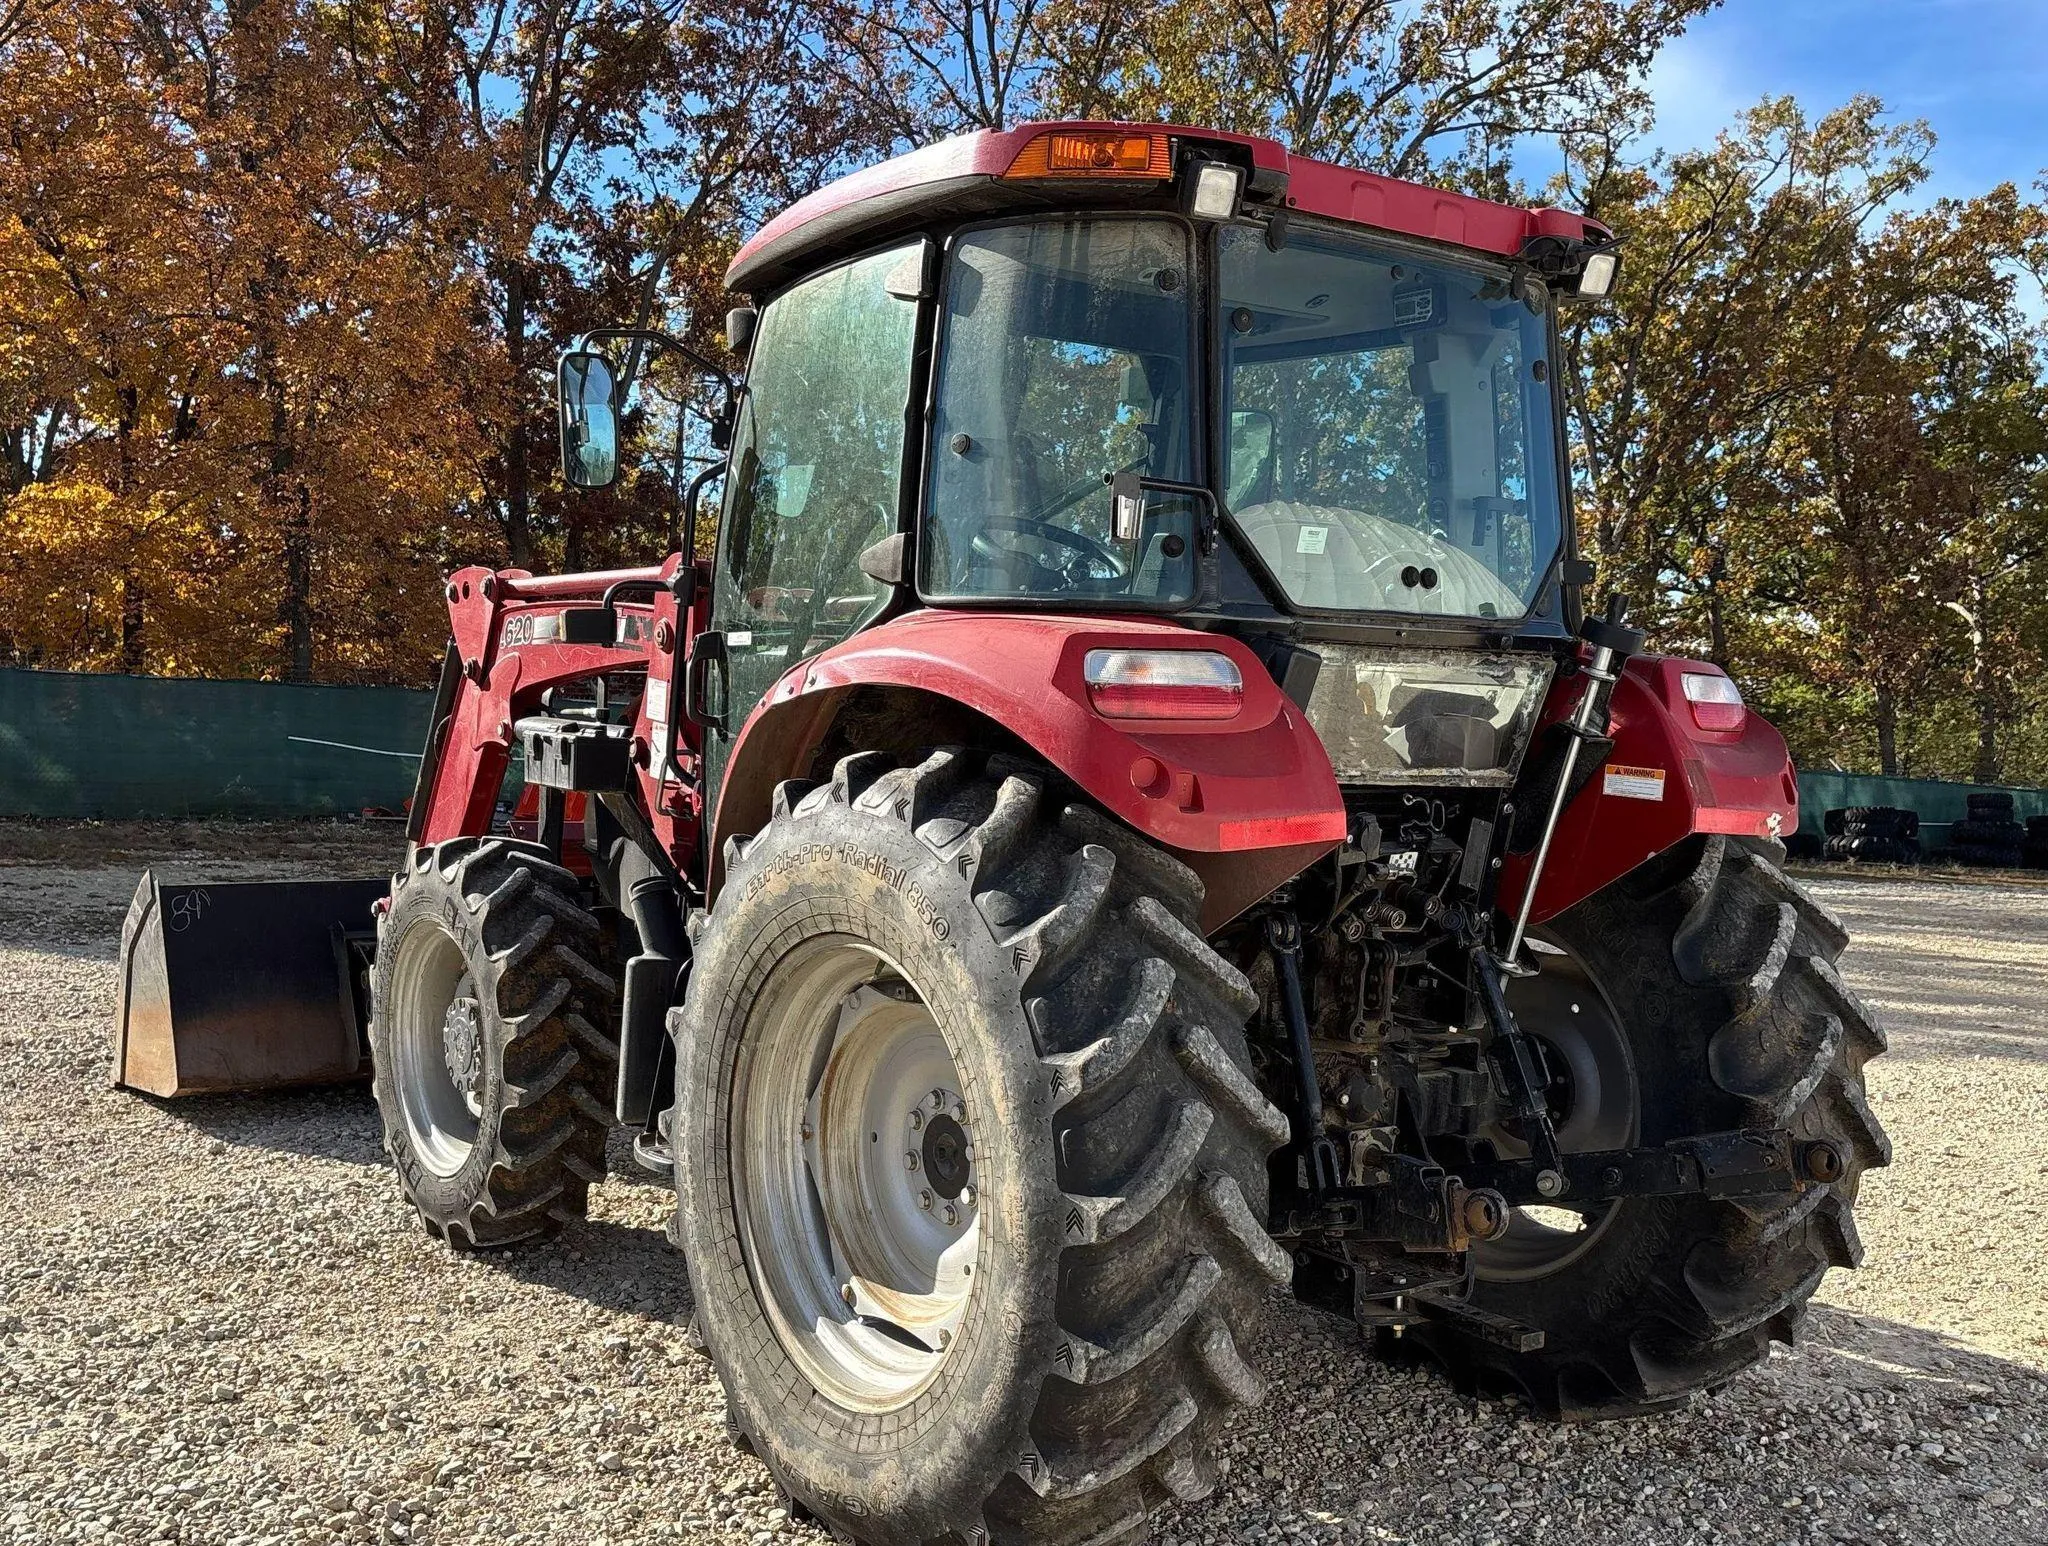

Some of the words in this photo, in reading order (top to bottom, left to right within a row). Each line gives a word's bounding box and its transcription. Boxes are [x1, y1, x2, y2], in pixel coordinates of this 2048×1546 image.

[500, 614, 533, 649] 620
[1623, 767, 1656, 779] WARNING
[746, 842, 833, 901] Earth-Pro
[841, 841, 907, 893] Radial
[906, 880, 951, 942] 850
